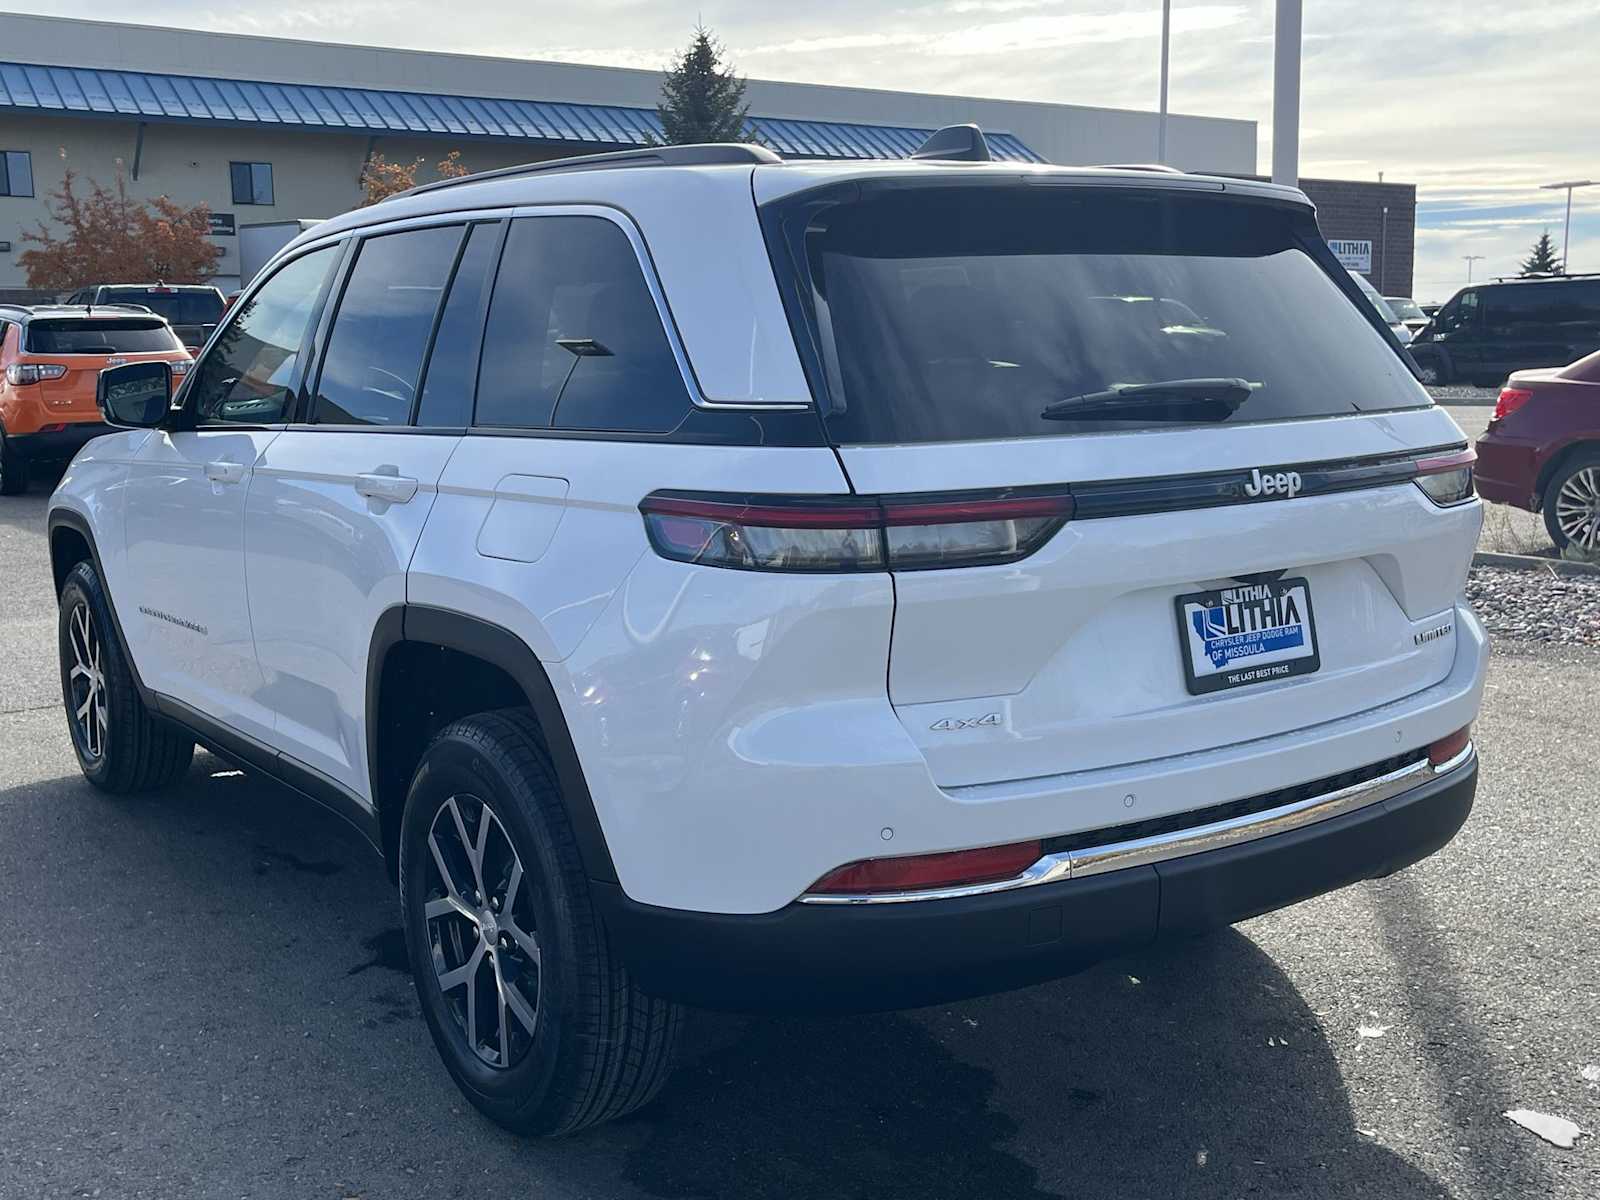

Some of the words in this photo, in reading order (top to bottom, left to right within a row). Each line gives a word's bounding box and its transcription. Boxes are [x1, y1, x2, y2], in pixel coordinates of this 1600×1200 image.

[1338, 242, 1370, 255] LITHIA
[1245, 469, 1302, 498] Jeep
[1232, 584, 1272, 603] LITHIA
[1225, 596, 1302, 634] LITHIA
[1211, 635, 1245, 649] CHRYSLER
[1246, 632, 1261, 643] JEEP
[1262, 628, 1284, 640] DODGE
[1285, 626, 1299, 635] RAM
[1212, 650, 1223, 661] OF
[1224, 643, 1266, 659] MISSOULA
[1228, 674, 1241, 684] THE
[1241, 671, 1256, 681] LAST
[1257, 668, 1271, 678] BEST
[1272, 665, 1289, 675] PRICE
[929, 712, 1001, 731] 4x4
